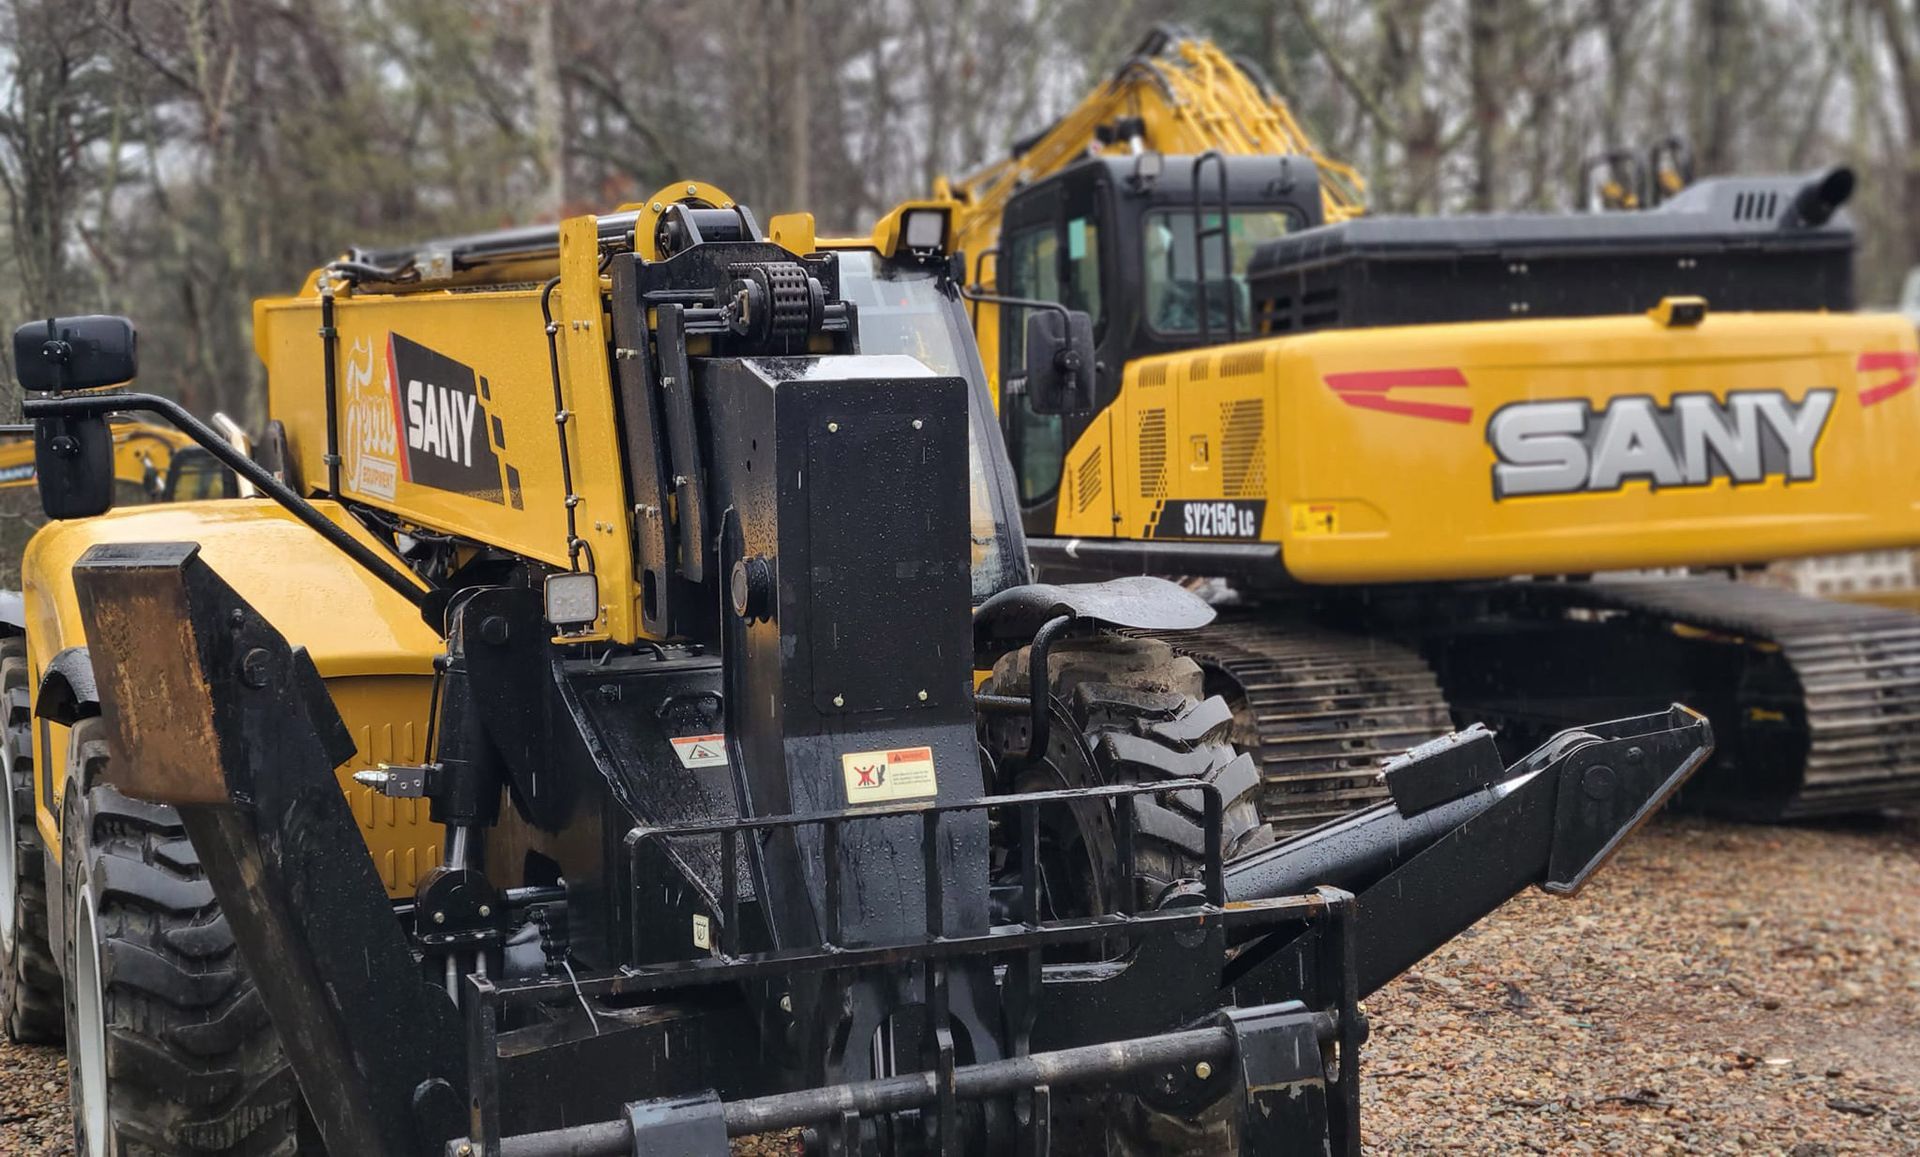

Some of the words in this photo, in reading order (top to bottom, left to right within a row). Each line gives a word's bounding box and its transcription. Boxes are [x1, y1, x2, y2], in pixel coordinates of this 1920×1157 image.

[407, 379, 476, 467] SANY
[1487, 388, 1837, 501] SANY
[1184, 502, 1236, 536] SY215C
[1238, 510, 1255, 536] LC
